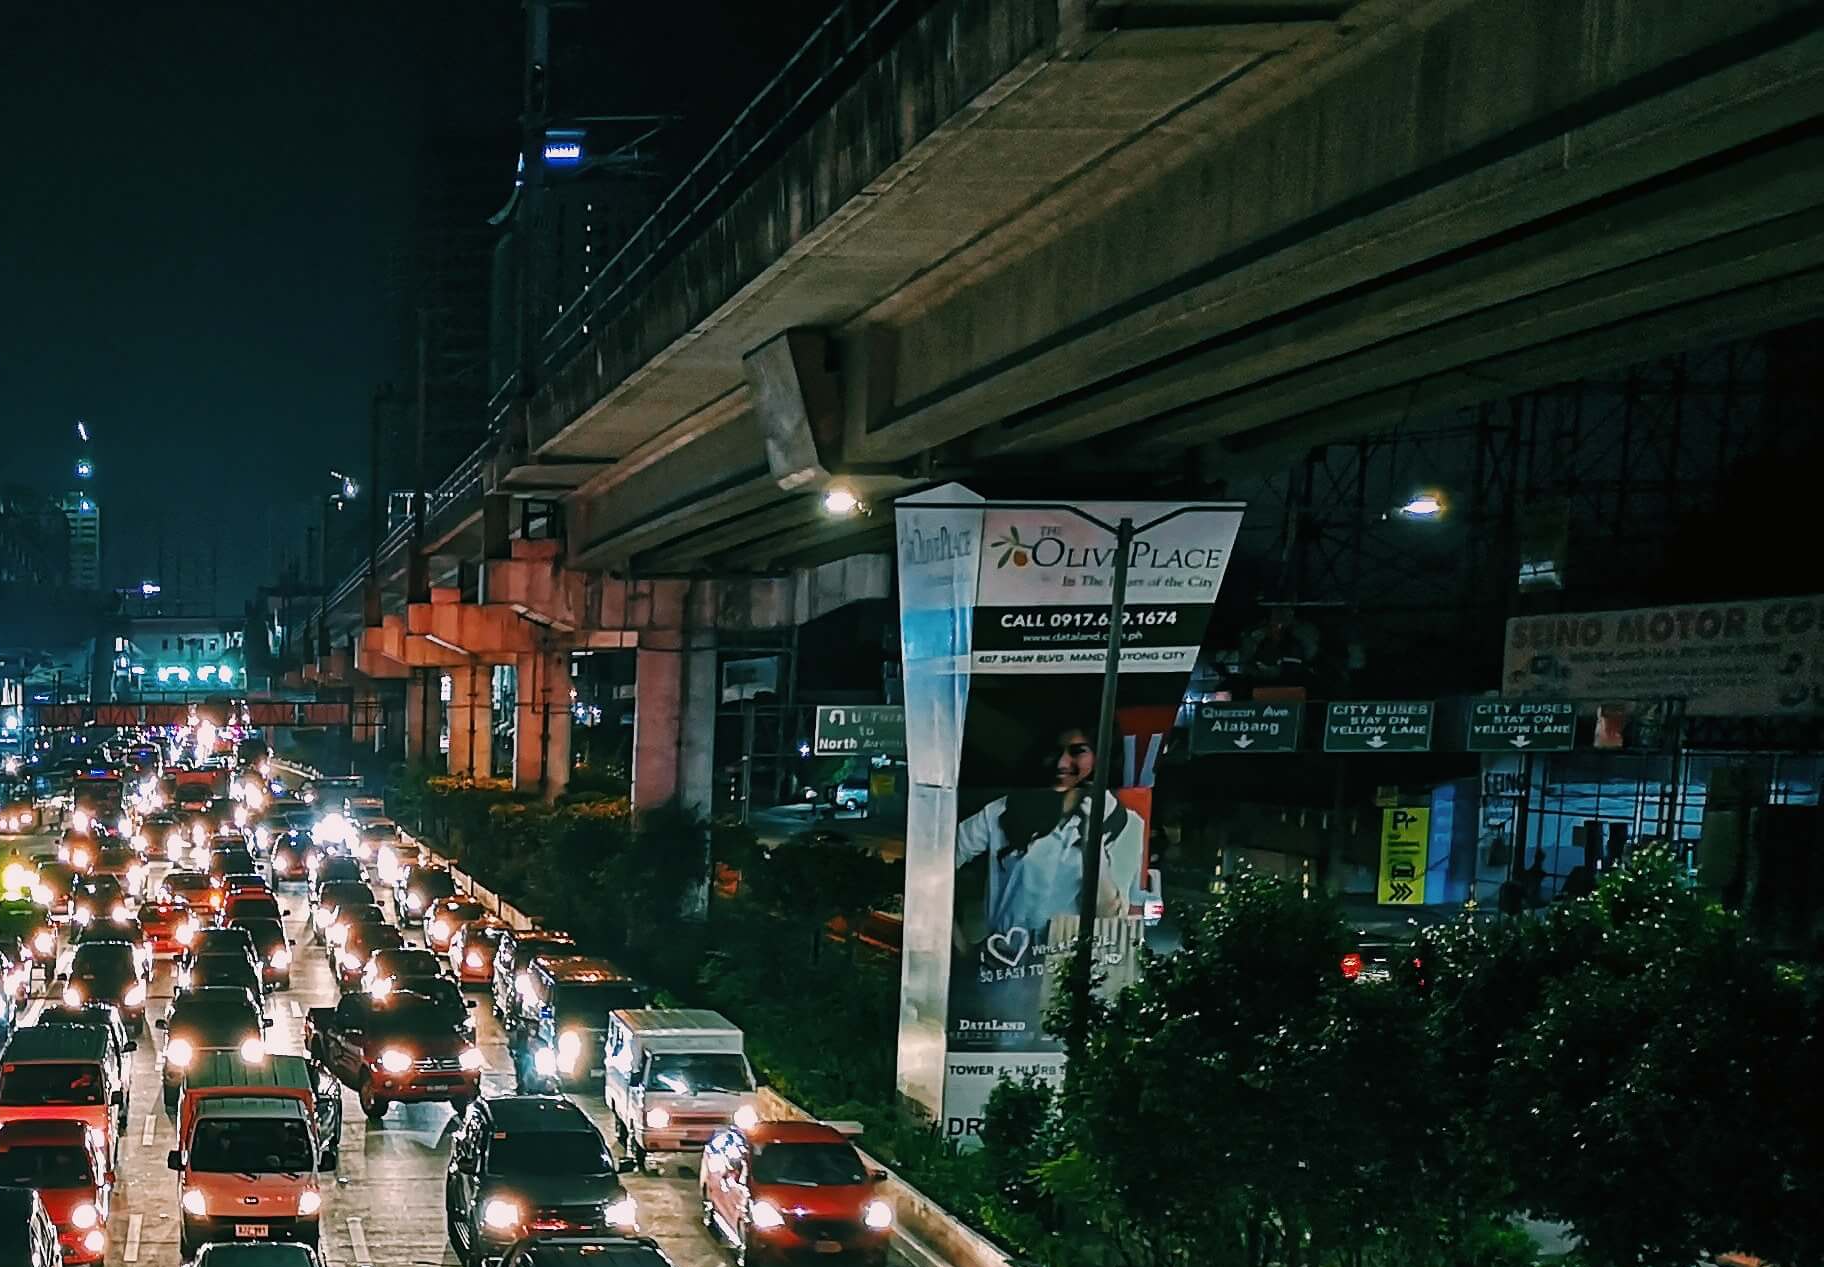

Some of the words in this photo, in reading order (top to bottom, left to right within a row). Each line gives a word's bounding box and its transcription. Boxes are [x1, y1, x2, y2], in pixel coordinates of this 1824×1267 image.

[1128, 541, 1223, 569] PLACE
[1082, 575, 1103, 587] The
[1164, 575, 1184, 587] the
[1188, 575, 1213, 588] City
[1000, 614, 1045, 628] CALL
[1050, 611, 1177, 627] 0917.69.1674
[1615, 607, 1746, 643] MOTOR
[1023, 631, 1144, 643] www.dataland.c.ph
[1000, 654, 1034, 664] SHAW
[1162, 651, 1186, 660] CITY
[1333, 704, 1369, 715] CITY
[1476, 704, 1512, 715] CITY
[1520, 703, 1572, 714] BUSES
[1350, 716, 1382, 726] STAY
[1494, 715, 1525, 724] STAY
[1534, 715, 1554, 724] ON
[1211, 720, 1280, 735] Alabang
[1330, 725, 1387, 735] YELLOW
[1391, 725, 1427, 735] LANE
[1474, 725, 1530, 735] YELLOW
[1534, 724, 1570, 735] LANE
[819, 737, 858, 750] North
[996, 967, 1025, 982] EASY
[950, 1065, 994, 1075] TOWER
